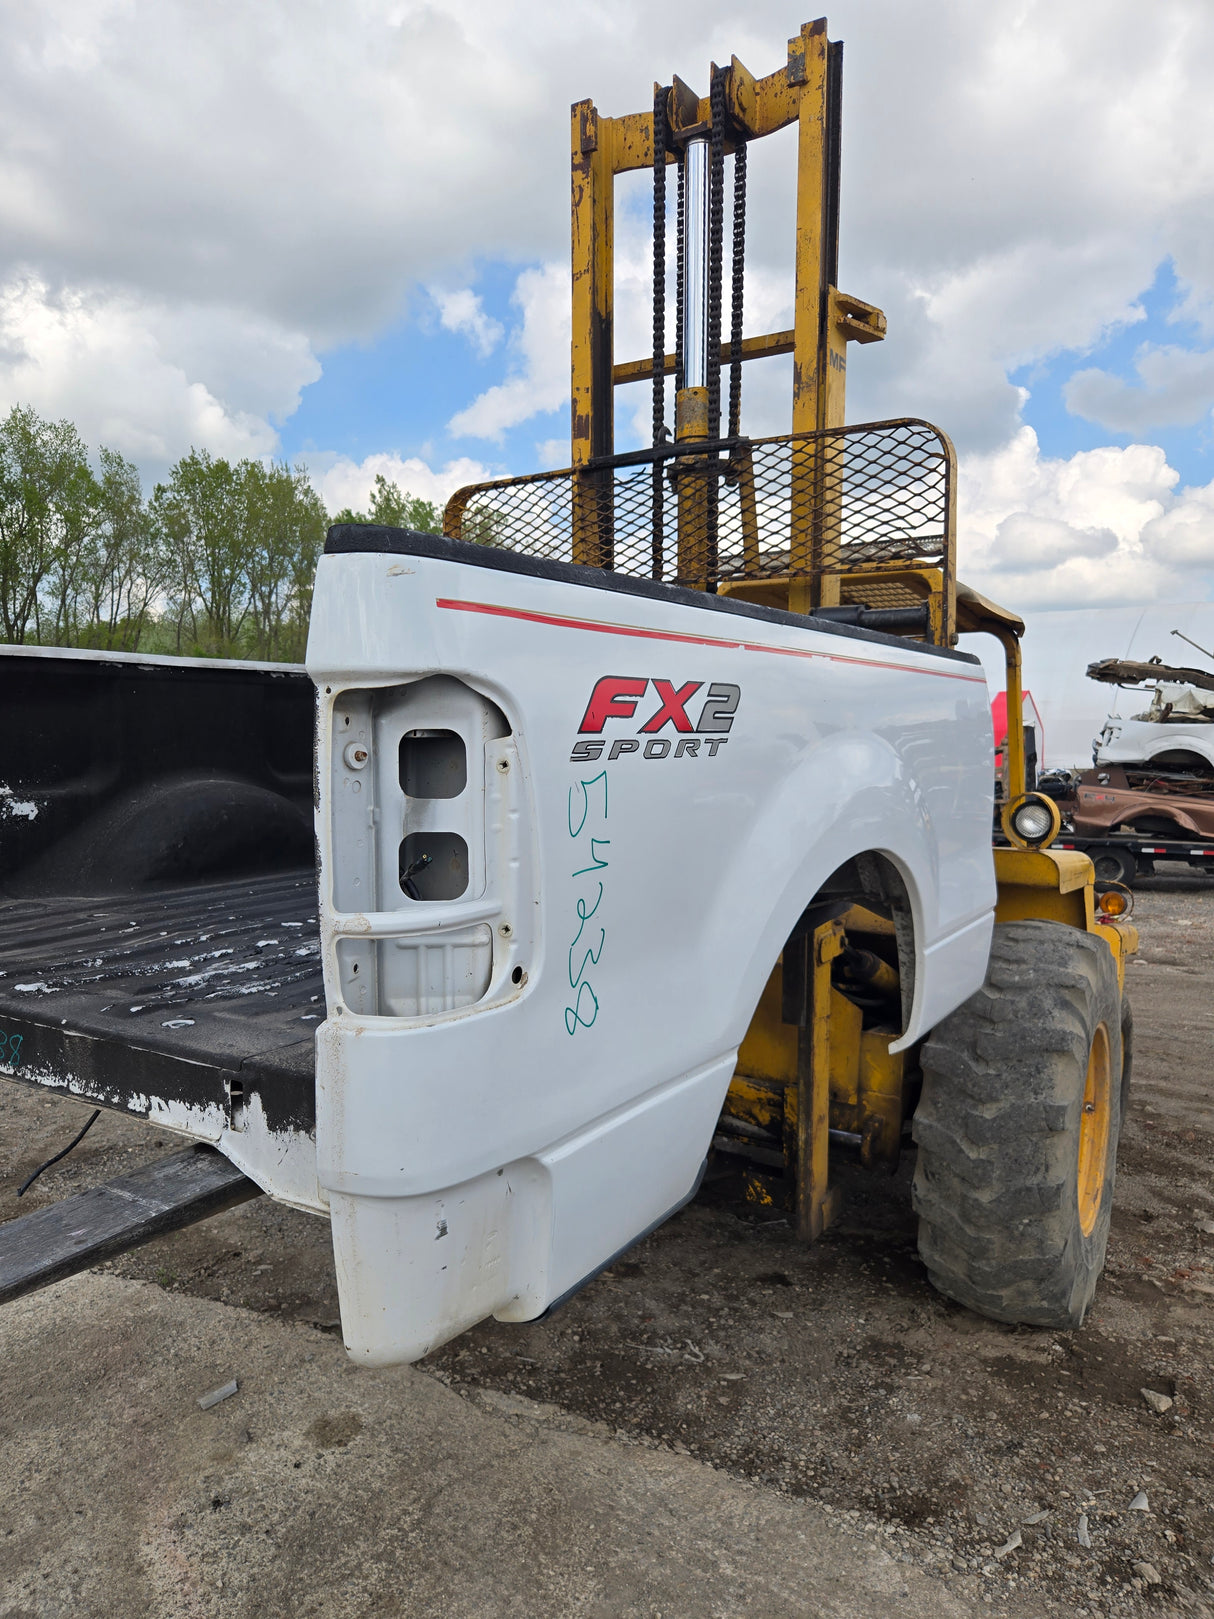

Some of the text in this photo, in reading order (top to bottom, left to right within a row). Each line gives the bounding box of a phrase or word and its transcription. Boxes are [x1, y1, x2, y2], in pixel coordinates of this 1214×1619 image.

[829, 348, 847, 373] MF
[577, 675, 741, 735] FX2
[570, 738, 729, 762] SPORT
[565, 770, 611, 1036] 54238
